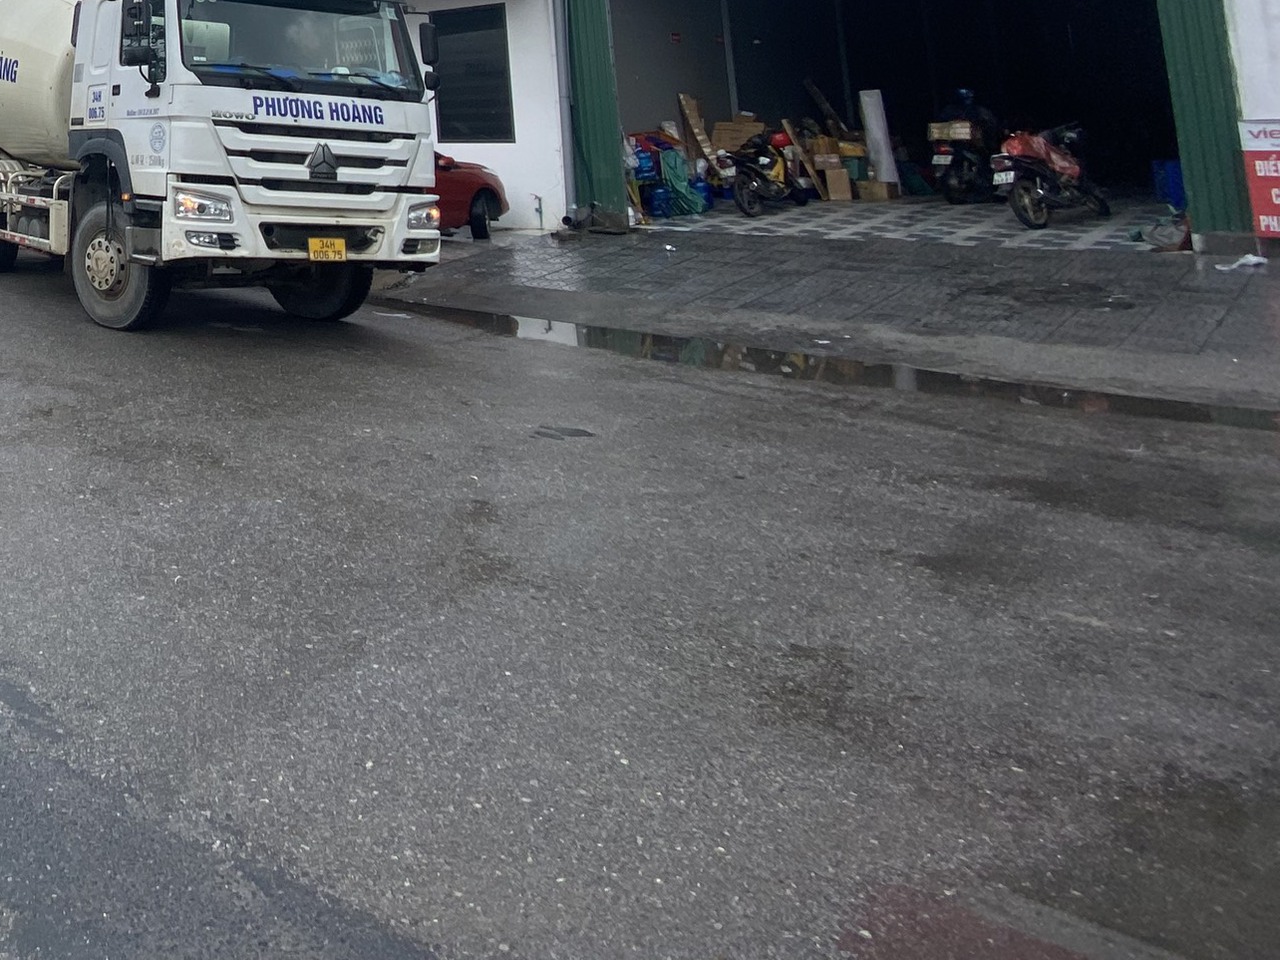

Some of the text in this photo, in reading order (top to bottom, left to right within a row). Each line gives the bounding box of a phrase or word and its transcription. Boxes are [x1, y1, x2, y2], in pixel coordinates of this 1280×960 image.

[211, 110, 256, 120] HOWO
[252, 96, 384, 125] PHƯỢNG HOÀNG
[319, 239, 336, 250] 34H
